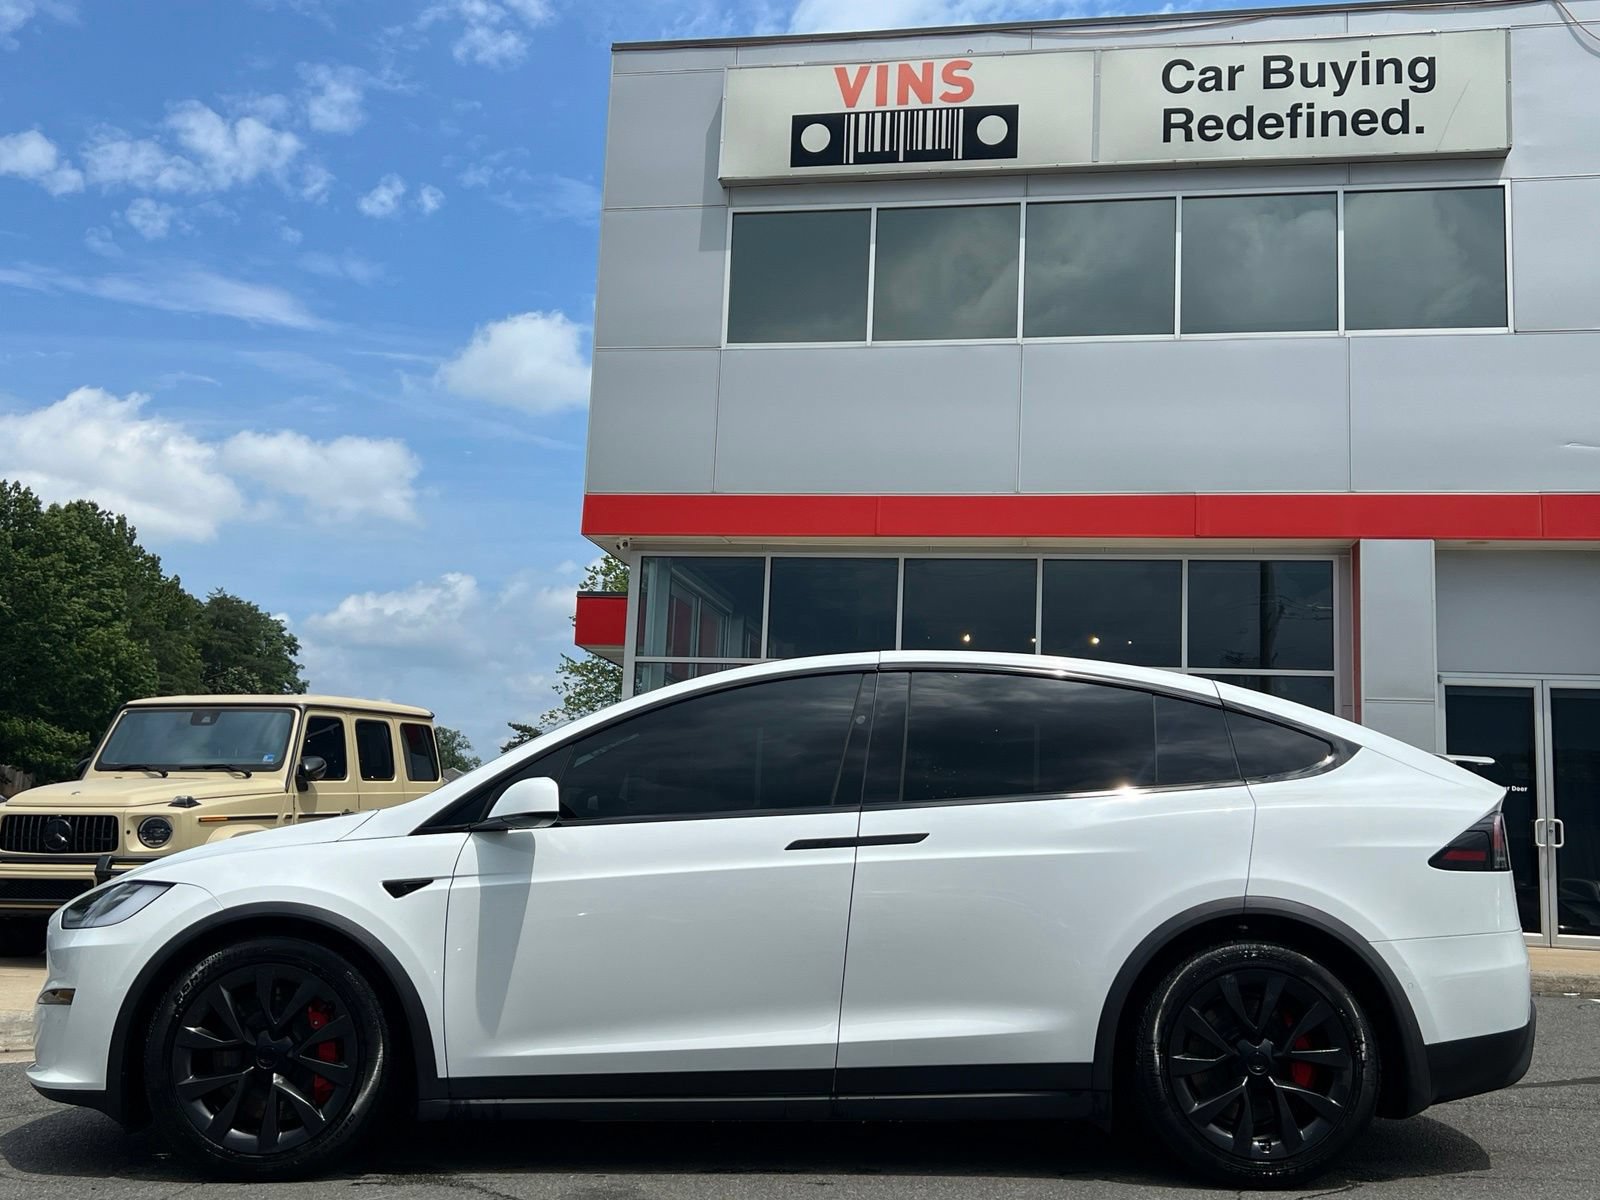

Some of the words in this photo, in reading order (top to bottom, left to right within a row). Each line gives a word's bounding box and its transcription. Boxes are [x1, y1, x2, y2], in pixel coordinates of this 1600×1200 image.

[835, 60, 975, 108] VINS
[1161, 58, 1245, 95] Car
[1262, 50, 1436, 97] Buying
[1162, 98, 1425, 144] Redefined.
